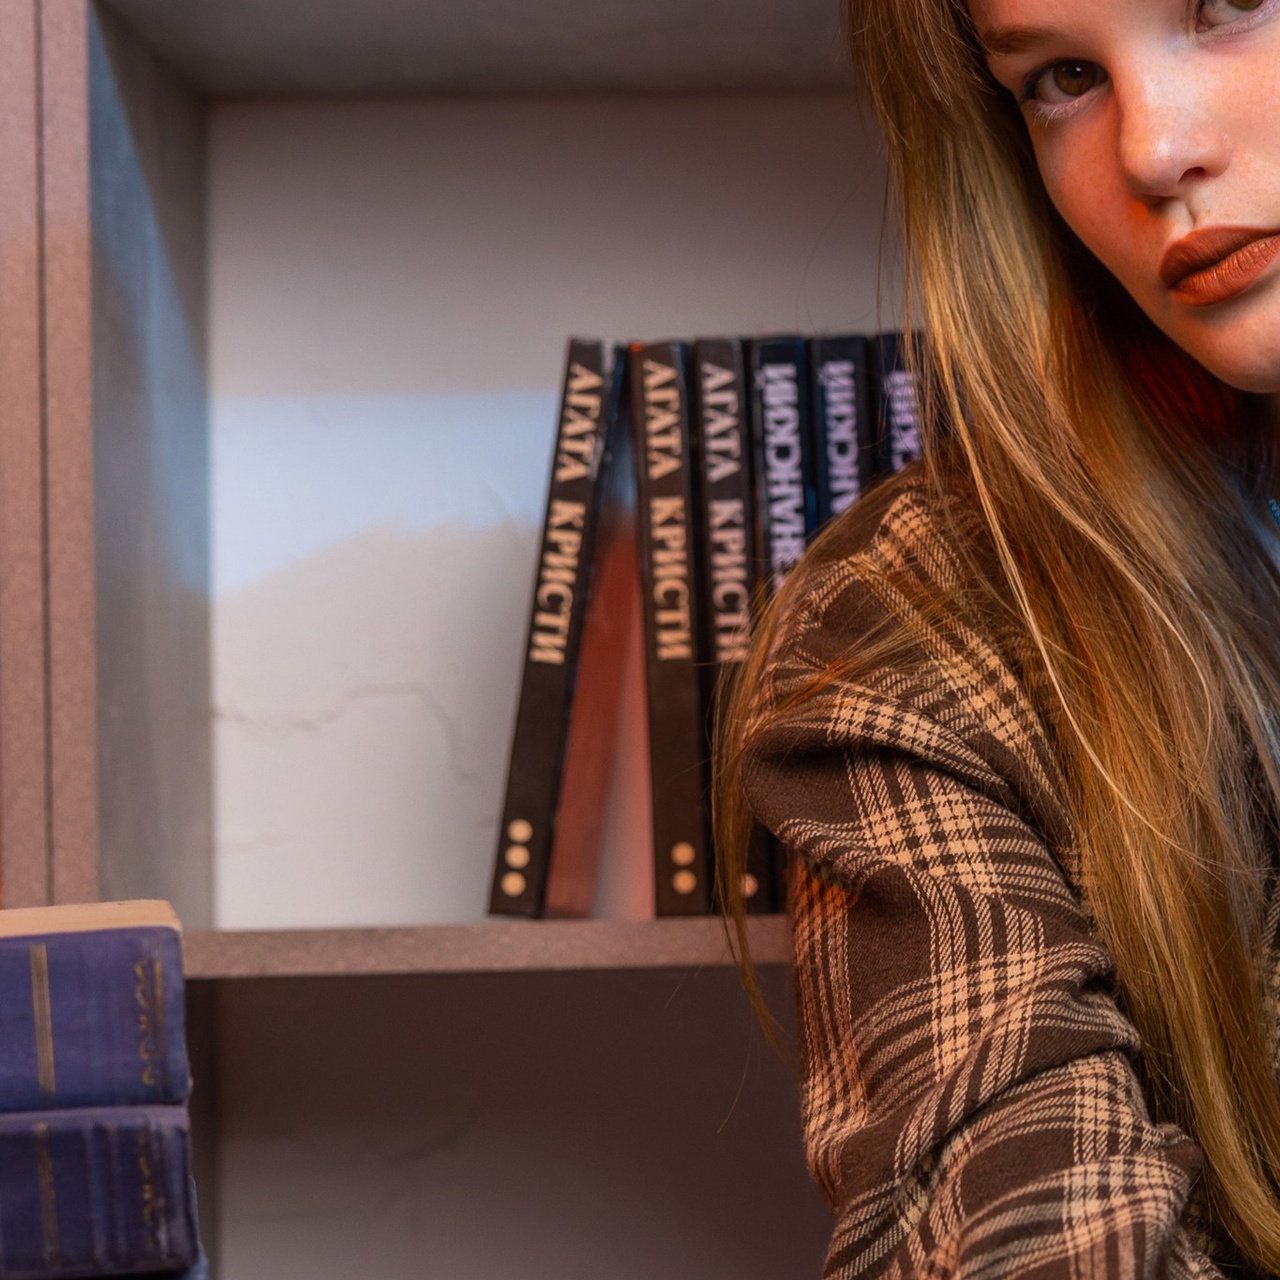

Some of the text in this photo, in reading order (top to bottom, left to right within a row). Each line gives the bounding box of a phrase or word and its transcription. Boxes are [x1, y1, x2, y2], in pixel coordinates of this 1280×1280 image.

[530, 361, 605, 666] АГАТА КРИСТИ
[643, 359, 692, 661] АГАТА КРИСТИ
[700, 361, 744, 483] АГАТА
[818, 359, 861, 514] АНСКИЙ
